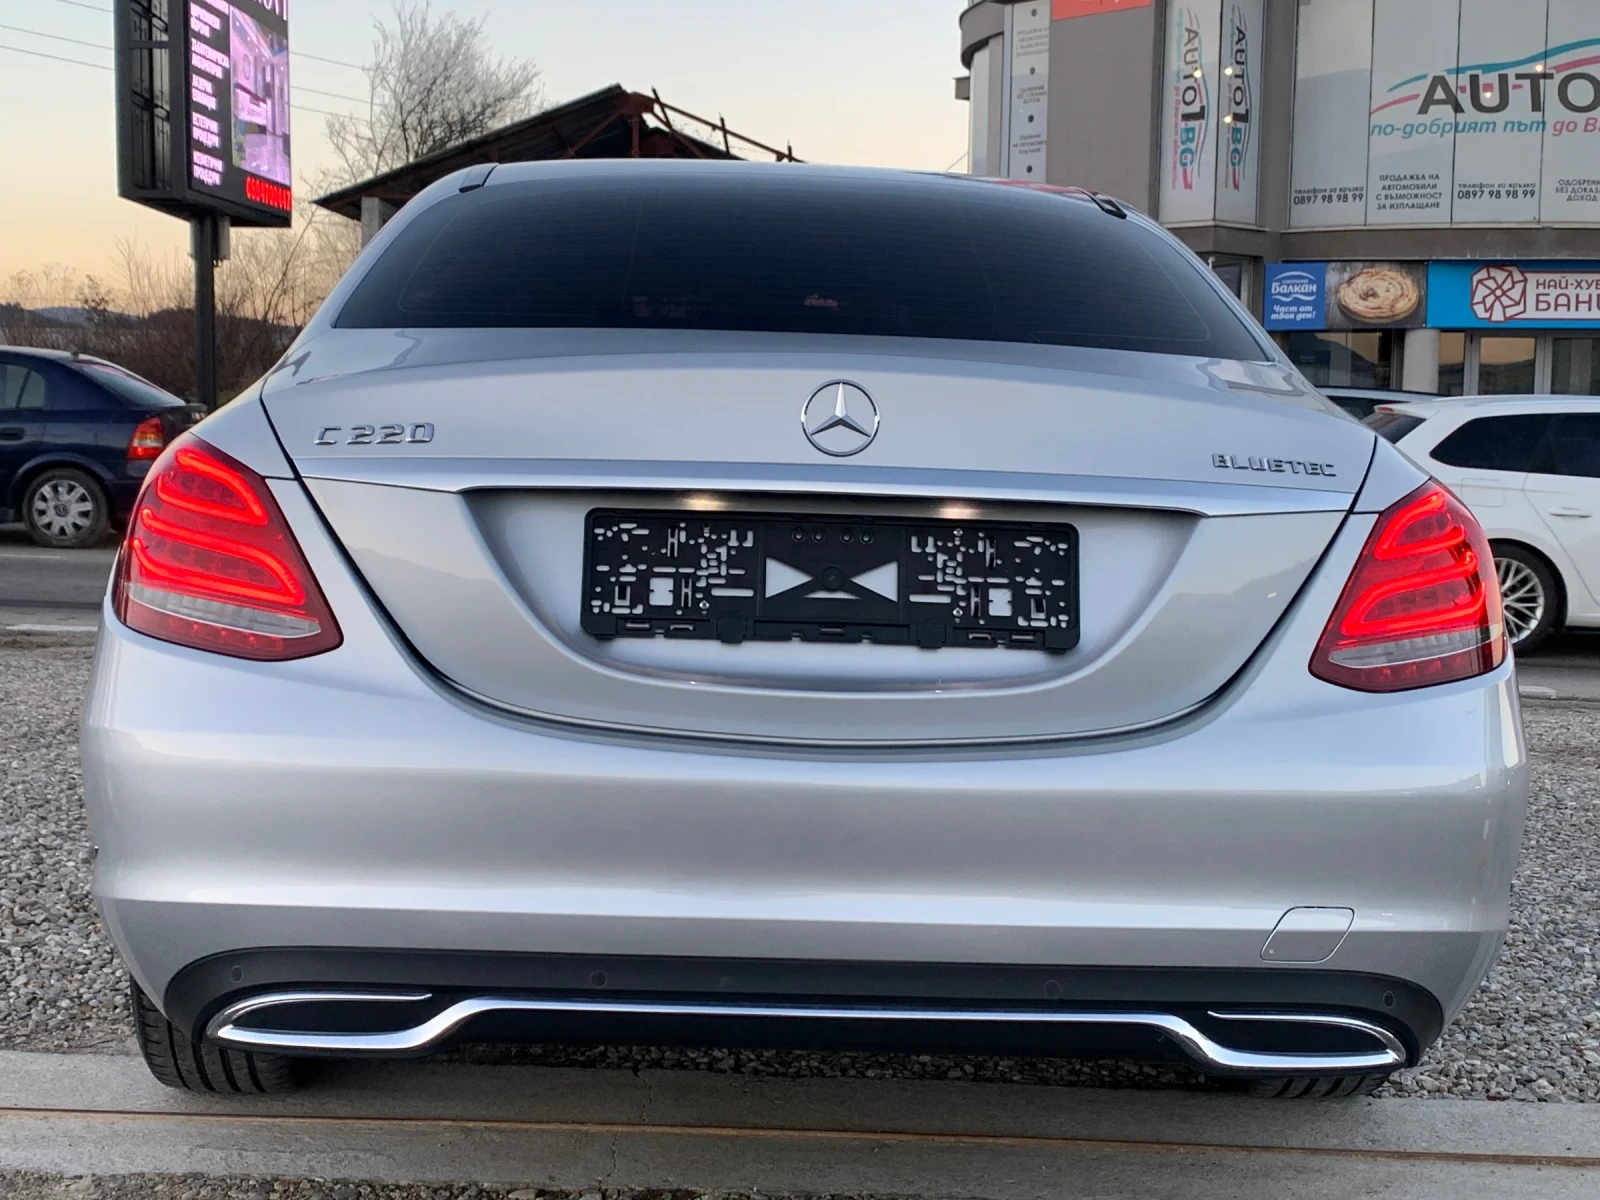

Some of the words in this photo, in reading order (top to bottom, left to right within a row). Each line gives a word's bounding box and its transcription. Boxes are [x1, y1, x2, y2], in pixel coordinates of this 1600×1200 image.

[1417, 72, 1600, 116] AUTO
[1370, 117, 1497, 138] по-добрият
[1503, 119, 1546, 133] път
[1552, 120, 1577, 137] до
[1583, 116, 1600, 133] В
[1379, 173, 1426, 182] ПРОДАЖБА
[1381, 183, 1437, 191] АВТОМОБИЛИ
[1570, 186, 1600, 194] ДОКАЗ
[1293, 194, 1318, 205] 0897
[1321, 194, 1333, 204] 98
[1336, 193, 1348, 203] 98
[1351, 192, 1364, 202] 99
[1384, 192, 1442, 200] ВЪЗМОЖНОСТ
[1457, 189, 1485, 200] 0897
[1488, 189, 1501, 199] 98
[1505, 189, 1518, 199] 98
[1522, 189, 1536, 199] 99
[1566, 194, 1598, 202] ДОХОД
[1389, 202, 1440, 210] ИЗПЛАЩАНЕ
[1271, 282, 1317, 294] Балкан
[1535, 293, 1600, 312] БАН
[1273, 304, 1298, 313] Част
[1296, 311, 1316, 321] ден!
[313, 425, 341, 446] C
[344, 422, 435, 446] 220
[1211, 453, 1337, 477] BLUETEC
